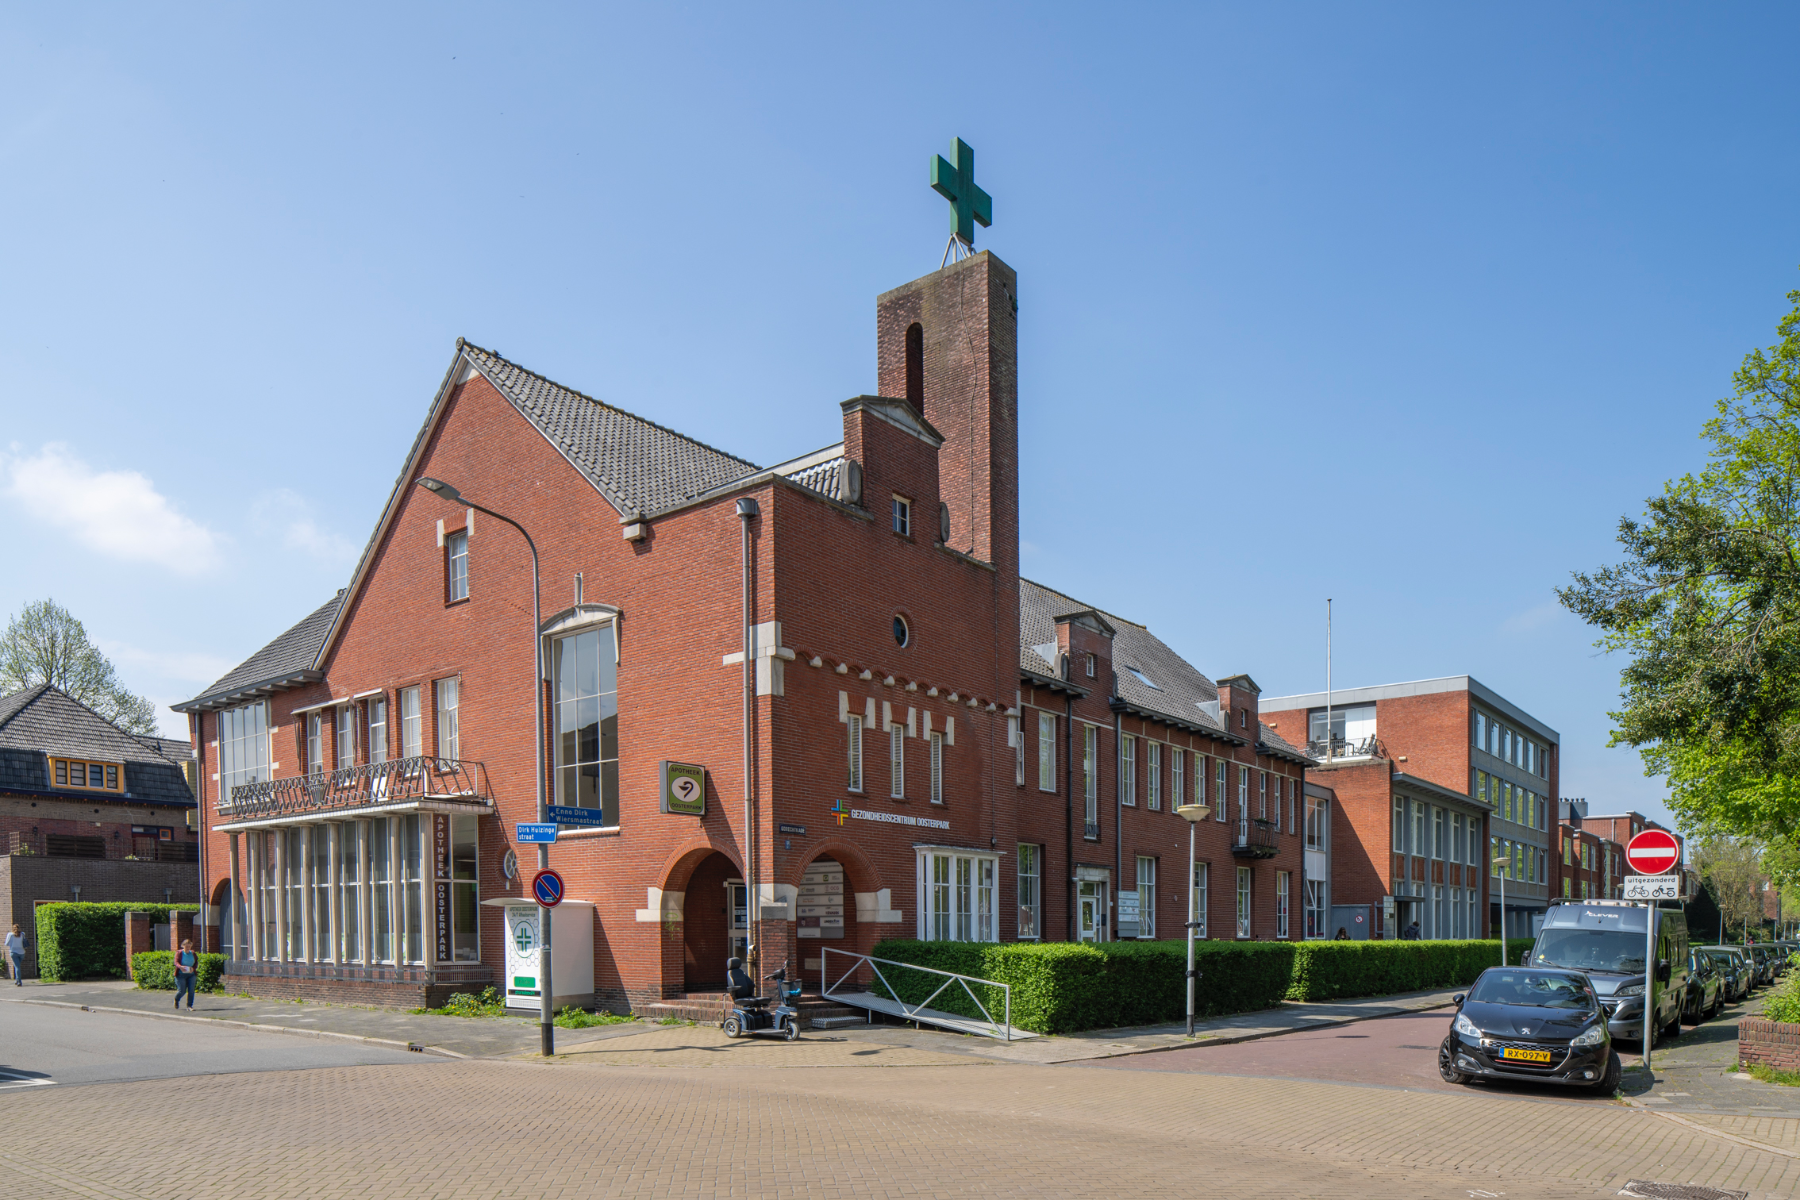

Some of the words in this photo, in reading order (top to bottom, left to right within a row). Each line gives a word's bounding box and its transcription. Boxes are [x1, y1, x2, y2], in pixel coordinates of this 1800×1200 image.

[671, 767, 700, 776] APOTHEEK
[671, 802, 702, 810] OOSTERPARK
[555, 808, 573, 816] Enno
[555, 816, 603, 825] Wiersmastraat
[851, 809, 916, 826] GEZONDHEIDSCENTRUM
[917, 817, 950, 829] OOSTERPARK
[531, 827, 554, 835] Huizinga
[437, 816, 445, 877] APOTHEEK
[438, 884, 446, 959] OOSTERPARK
[1508, 1050, 1548, 1060] RX-097-V
